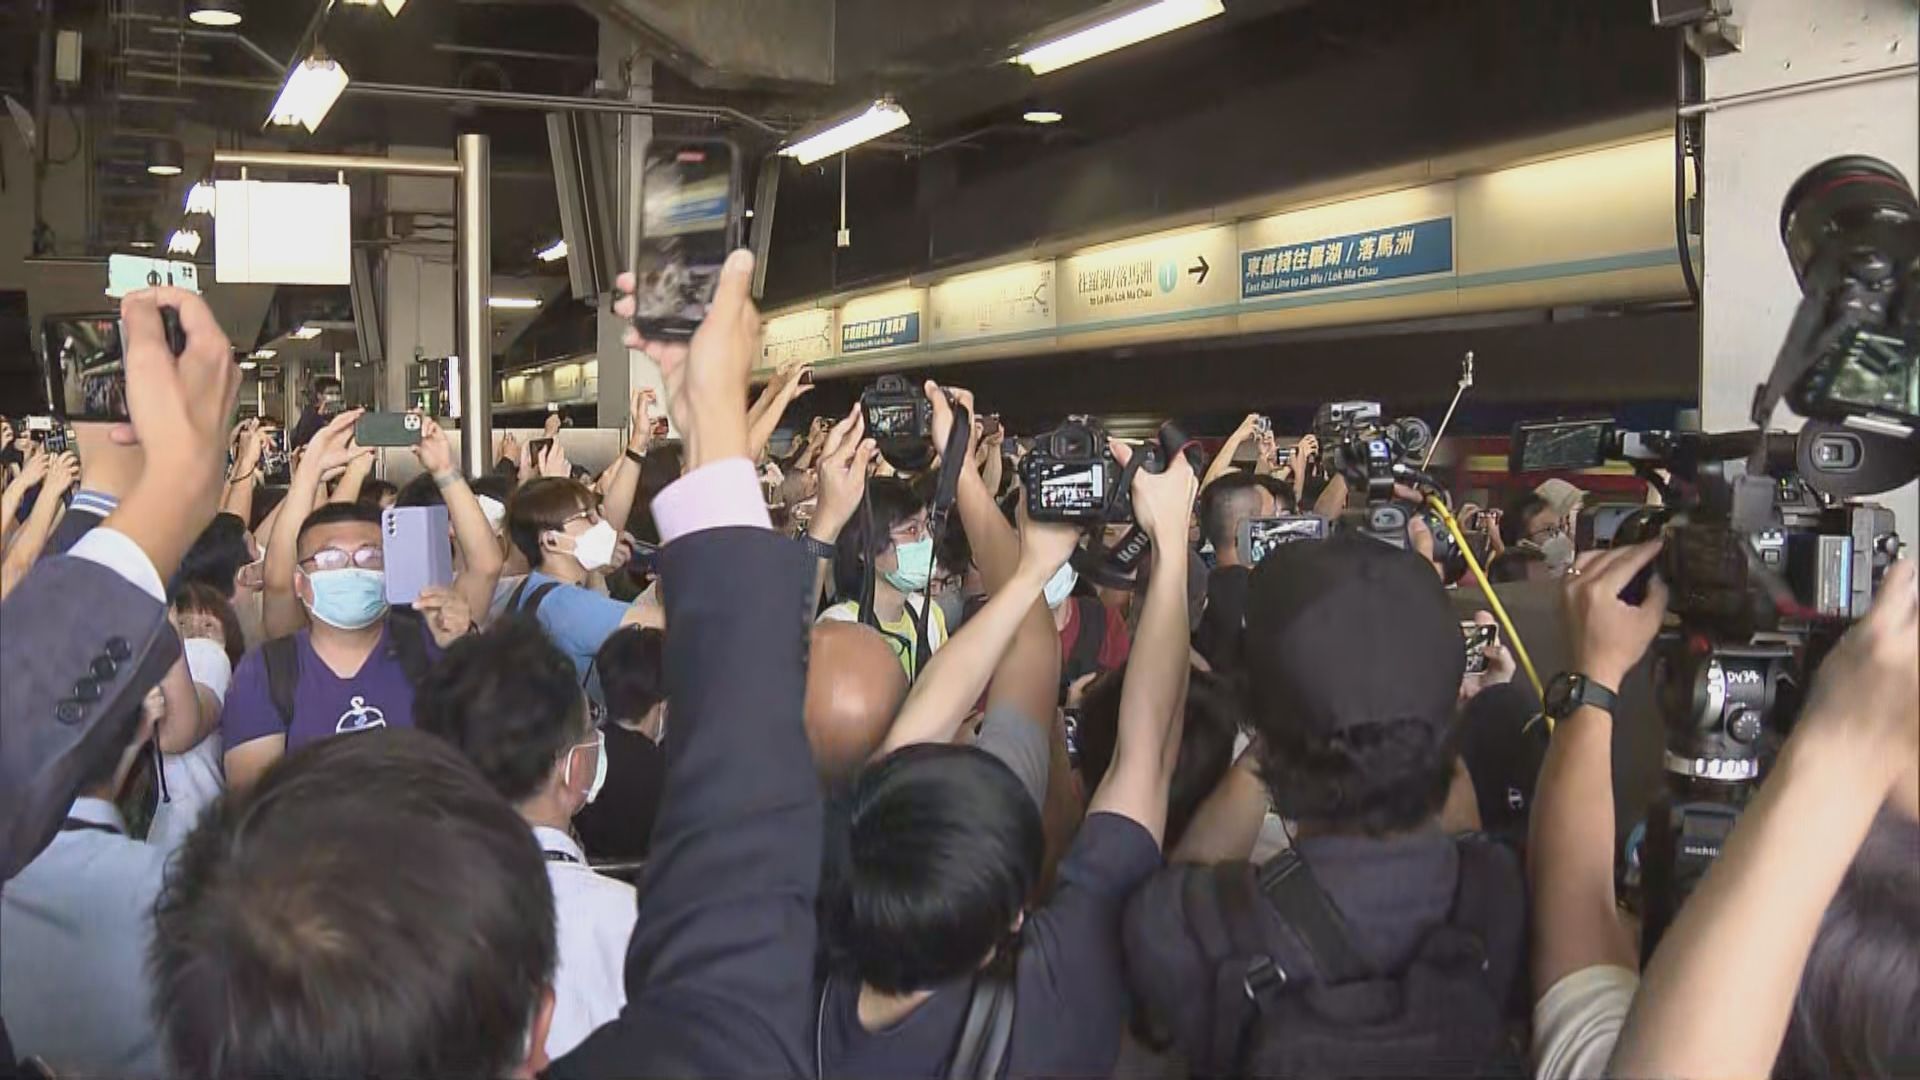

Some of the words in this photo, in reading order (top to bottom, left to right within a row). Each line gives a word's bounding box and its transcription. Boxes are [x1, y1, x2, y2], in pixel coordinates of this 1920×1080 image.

[1358, 229, 1415, 261] 落馬洲
[1245, 281, 1260, 293] East
[1261, 279, 1274, 291] Rail
[1275, 278, 1290, 289] Line
[1291, 278, 1300, 288] to
[1300, 275, 1309, 285] Lo
[1310, 273, 1323, 284] Wu
[1328, 270, 1342, 281] Lok
[1343, 268, 1356, 279] Ma
[1358, 265, 1379, 277] Chau
[1127, 289, 1136, 299] Ma
